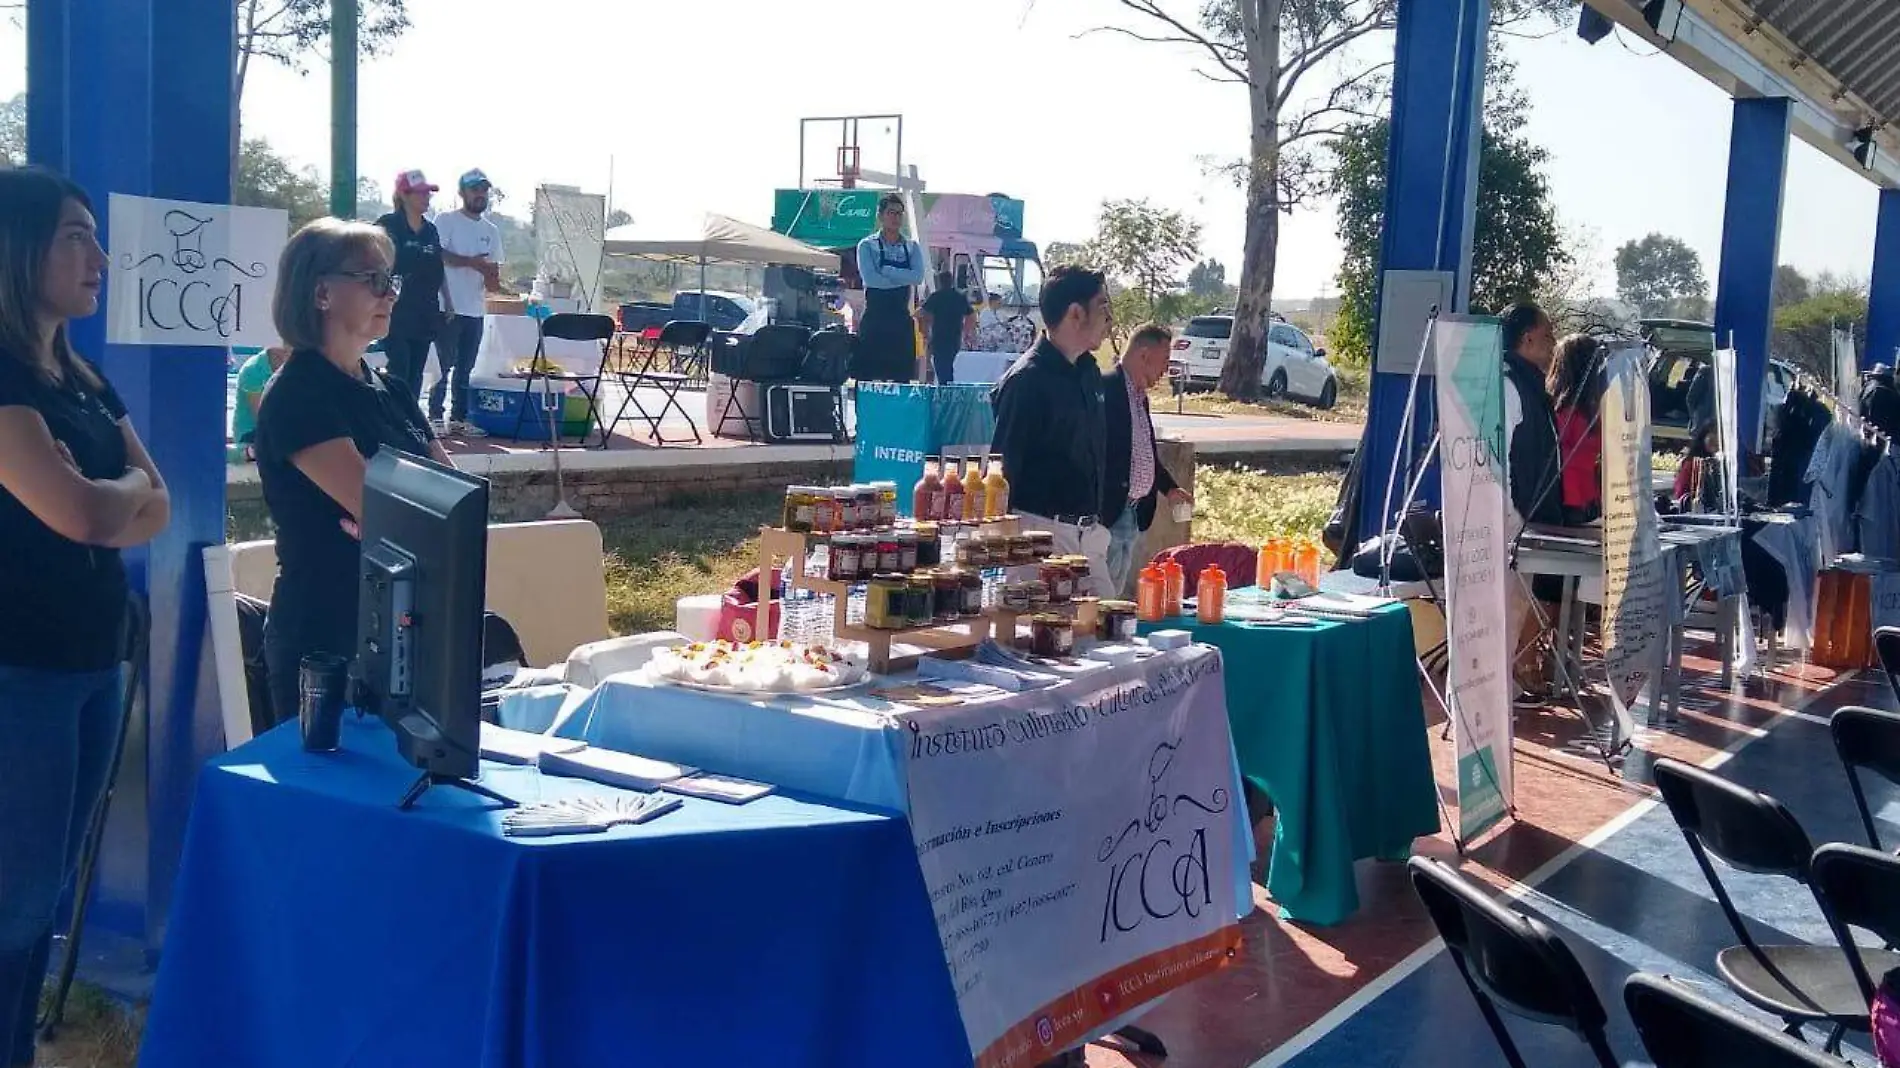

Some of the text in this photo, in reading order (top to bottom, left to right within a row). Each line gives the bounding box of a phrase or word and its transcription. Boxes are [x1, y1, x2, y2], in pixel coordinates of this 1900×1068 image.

[138, 277, 242, 338] ICCA
[908, 719, 1006, 760] Instituto
[1100, 828, 1212, 943] ICCA
